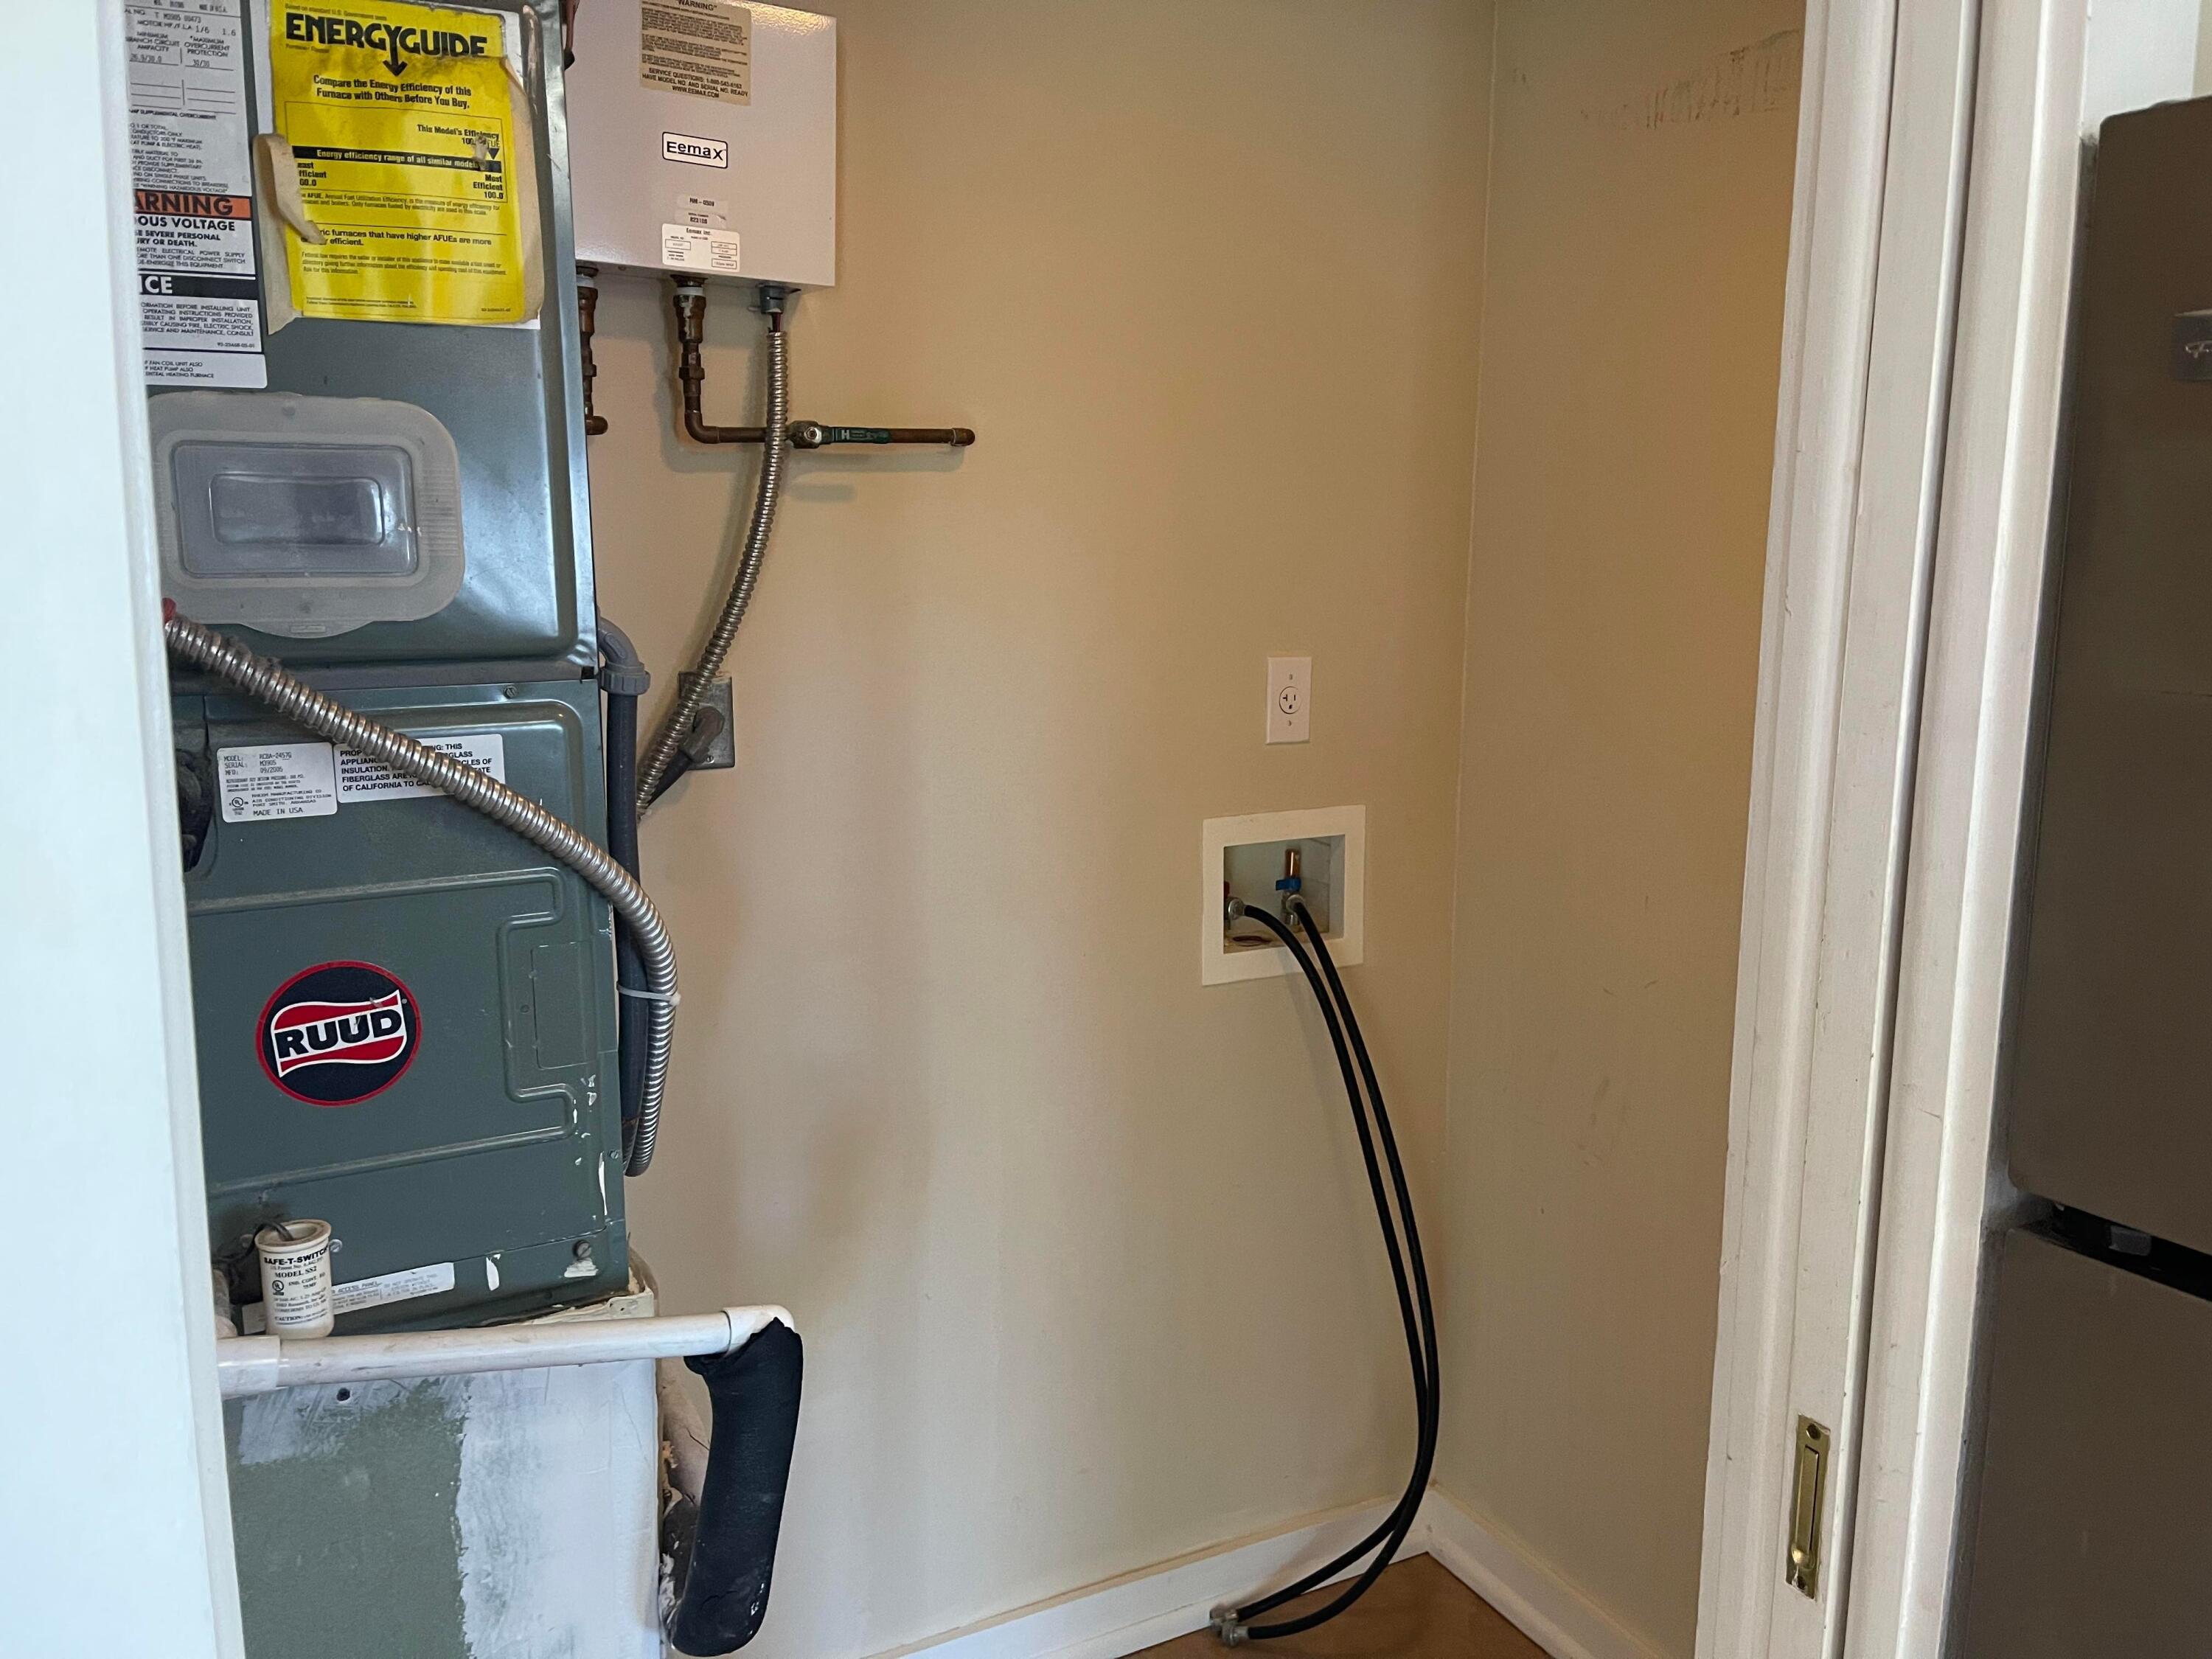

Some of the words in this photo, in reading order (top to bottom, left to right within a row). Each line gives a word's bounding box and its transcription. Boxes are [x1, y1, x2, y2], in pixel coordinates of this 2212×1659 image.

[286, 12, 487, 56] ENERGYGUIDE
[184, 42, 229, 50] OVERCURRENT
[187, 49, 228, 57] PROTECTION
[649, 68, 672, 77] SERVICE
[313, 75, 351, 88] Compare
[354, 79, 367, 88] the
[369, 80, 398, 92] Energy
[400, 82, 442, 94] Efficiency
[445, 85, 453, 94] of
[456, 86, 470, 95] this
[658, 76, 677, 84] MODEL
[731, 88, 748, 97] READY
[672, 86, 719, 98] WWW.EEMAX.COM
[317, 88, 352, 100] Furnace
[354, 91, 372, 100] with
[375, 92, 402, 102] Others
[405, 94, 432, 104] Before
[436, 97, 449, 105] You
[452, 98, 470, 109] Buy.
[417, 125, 432, 133] This
[434, 127, 462, 136] Model's
[317, 150, 342, 159] Energy
[344, 152, 381, 161] efficiency
[384, 155, 404, 164] range
[417, 156, 425, 164] all
[428, 158, 452, 166] similar
[299, 170, 326, 178] fficient
[485, 174, 502, 183] Most
[473, 182, 503, 191] Efficient
[136, 193, 233, 215] ARNING
[134, 216, 167, 226] OUS
[172, 218, 235, 231] VOLTAGE
[177, 232, 220, 240] PERSONAL
[332, 229, 366, 237] furnaces
[386, 232, 405, 240] have
[406, 232, 431, 242] higher
[433, 234, 457, 243] AFUEs
[330, 237, 364, 246] efficient.
[140, 276, 173, 293] ICE
[841, 430, 849, 439] H
[448, 751, 473, 759] GLASS
[342, 774, 390, 782] FIBERGLASS
[355, 782, 402, 790] CALIFORNIA
[275, 1009, 402, 1059] RUUD
[305, 1266, 317, 1274] SS2
